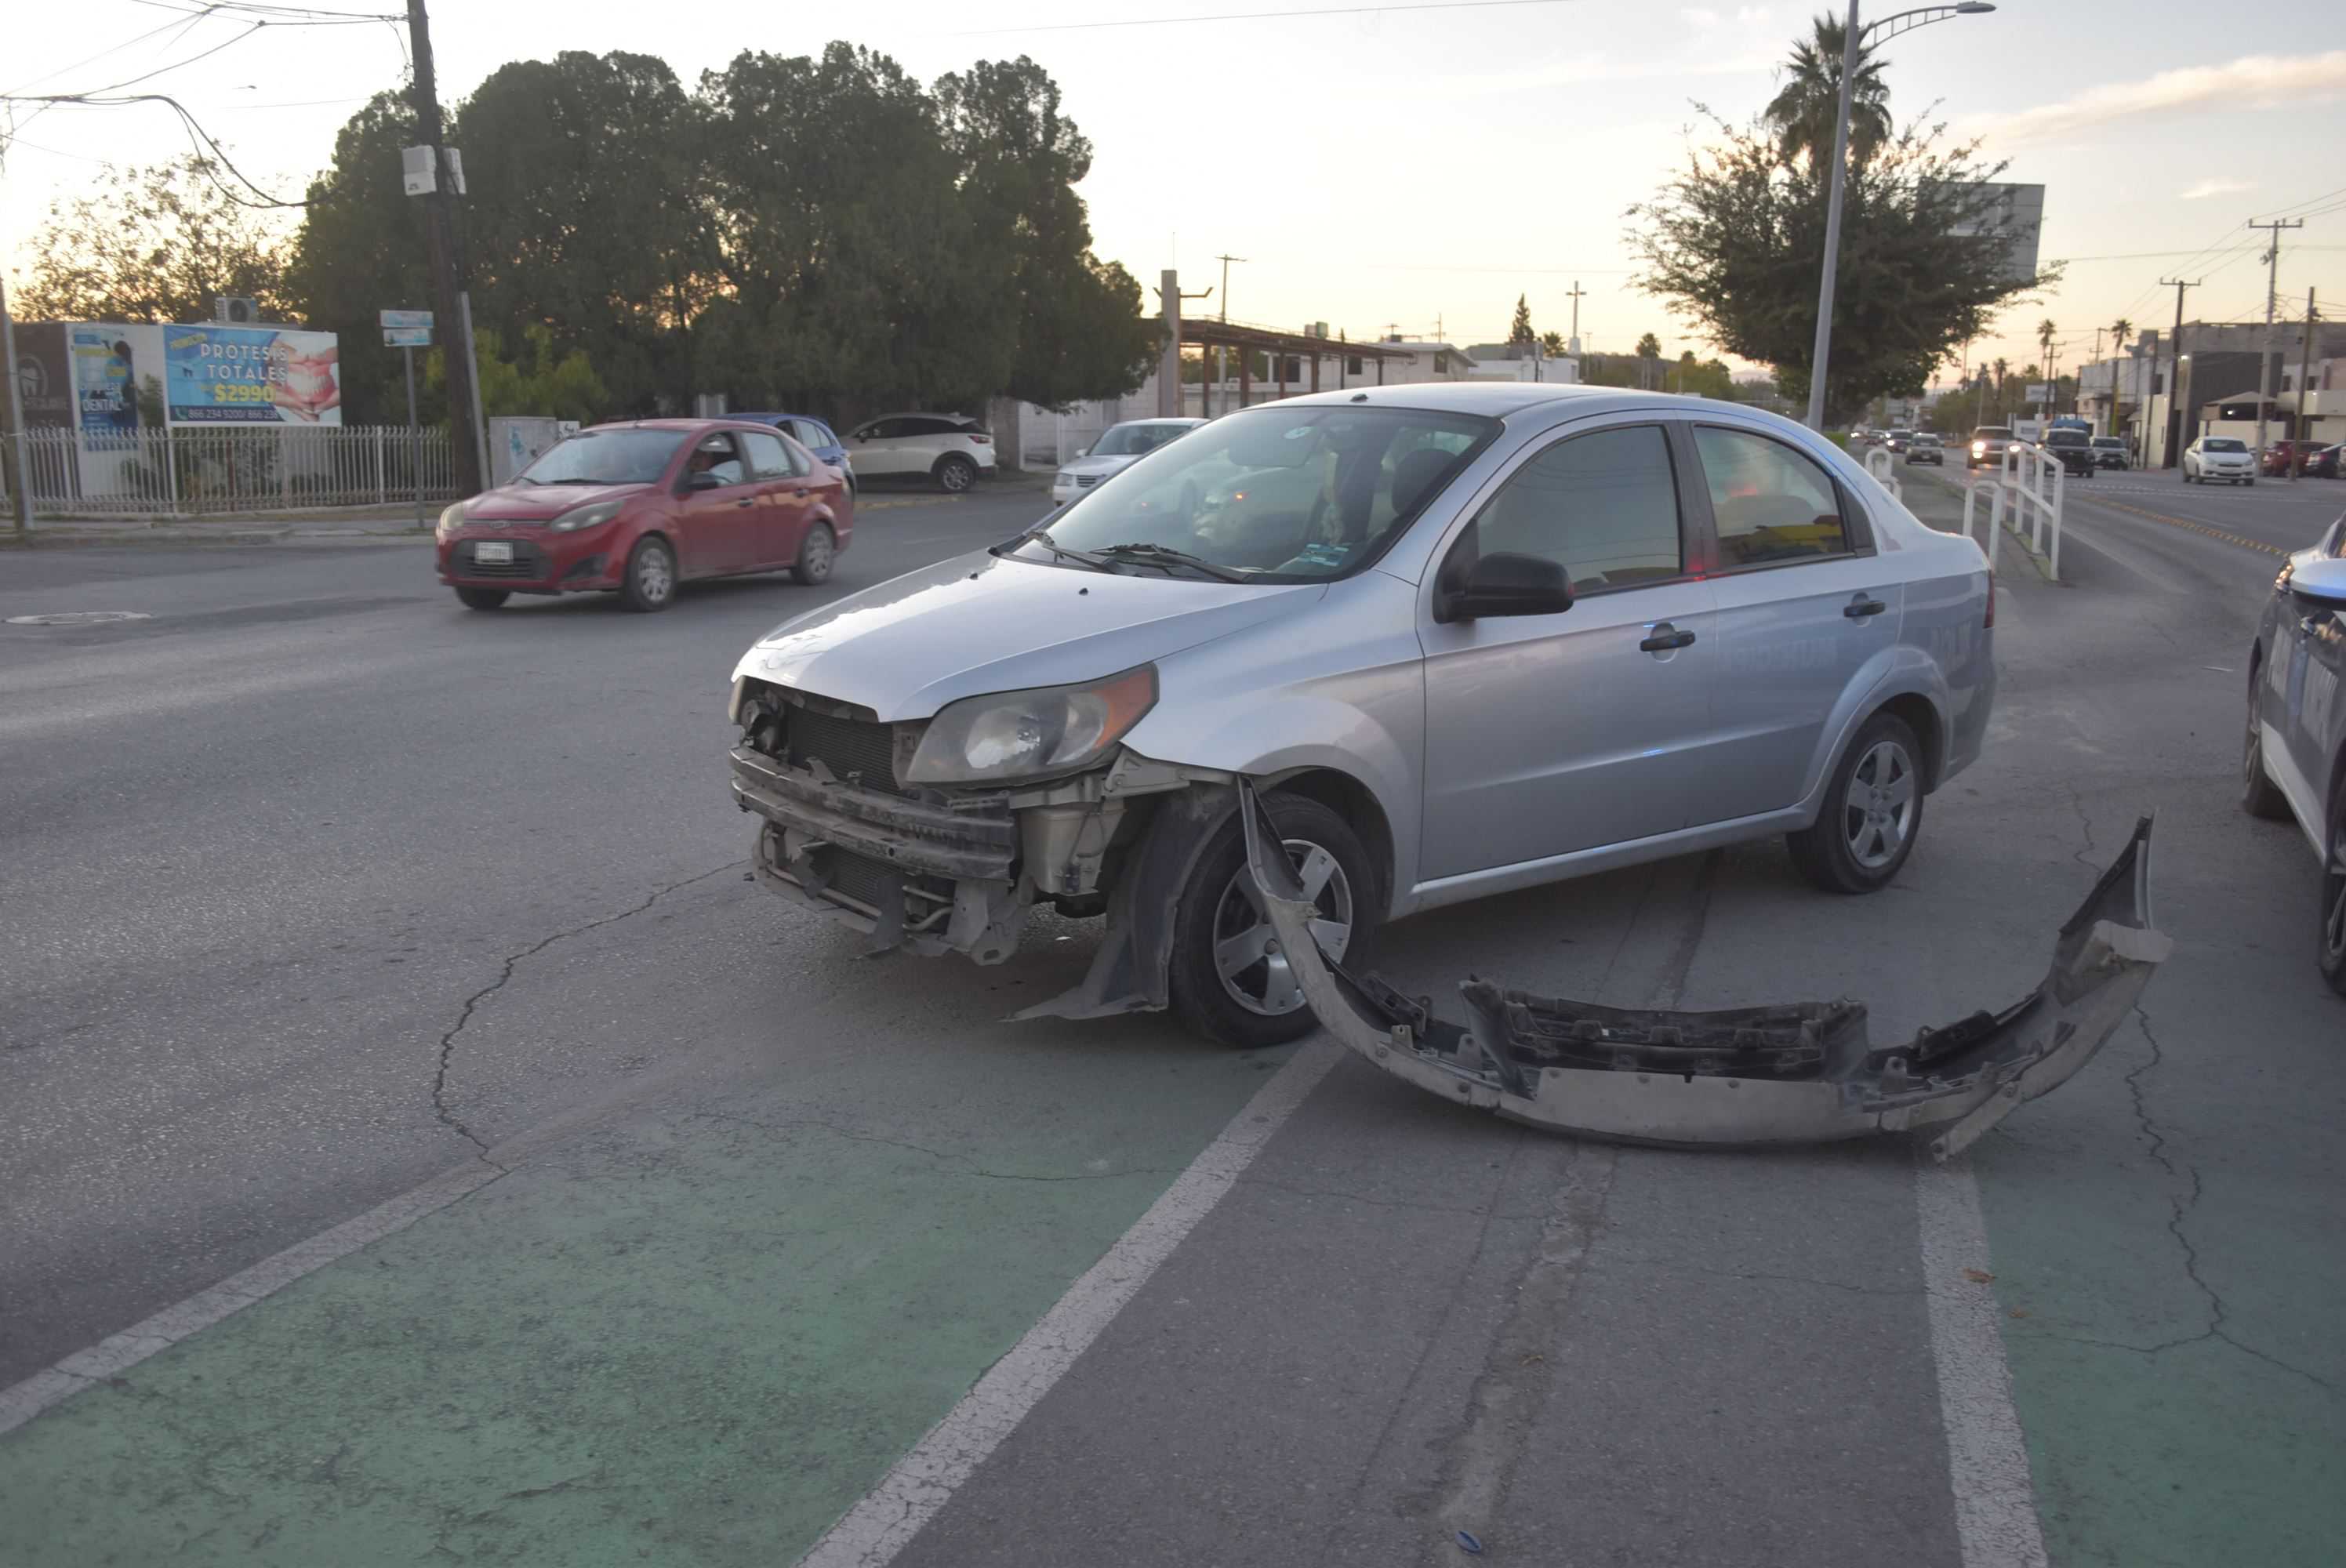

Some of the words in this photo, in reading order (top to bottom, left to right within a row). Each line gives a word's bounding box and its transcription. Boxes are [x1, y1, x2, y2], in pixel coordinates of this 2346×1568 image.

[207, 365, 288, 381] TOTALES
[214, 383, 276, 402] $2990
[82, 399, 122, 412] DENTAL
